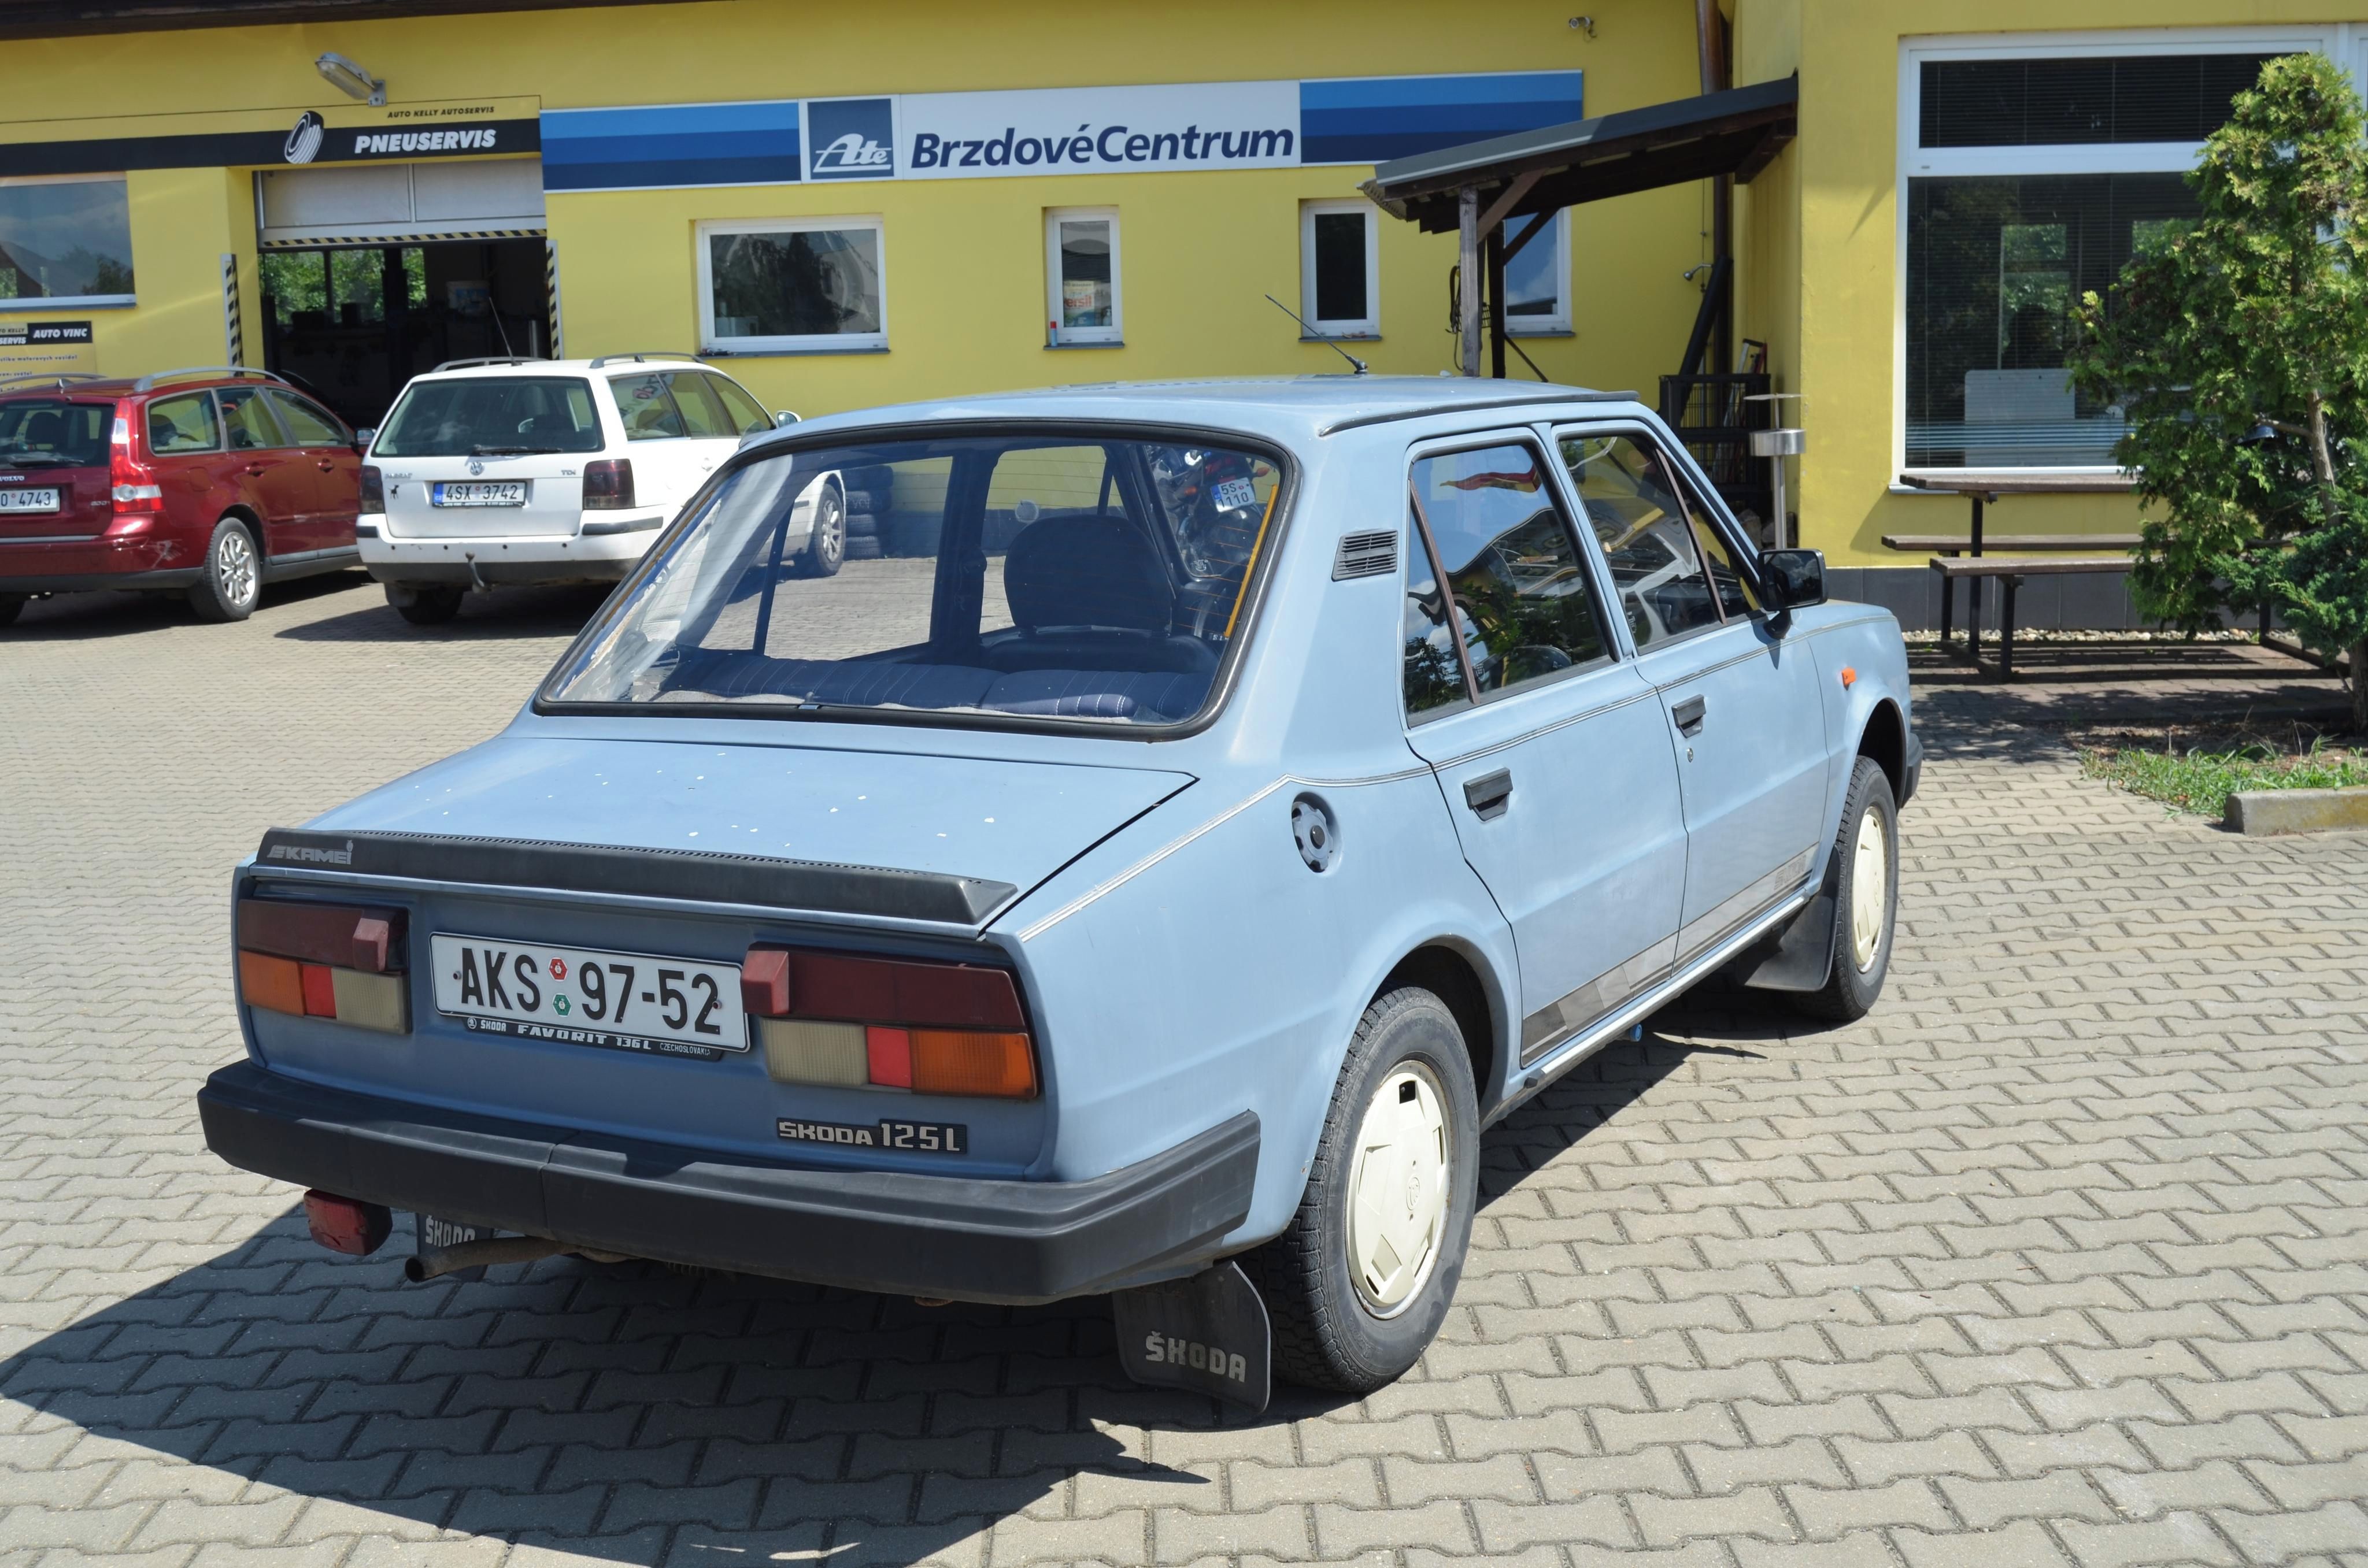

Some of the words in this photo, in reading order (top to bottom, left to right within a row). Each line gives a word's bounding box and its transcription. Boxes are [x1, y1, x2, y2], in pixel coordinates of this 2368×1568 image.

[387, 110, 411, 118] AUTO
[413, 109, 438, 117] KELLY
[354, 128, 497, 154] PNEUSERVIS
[33, 329, 61, 339] AUTO
[63, 328, 88, 338] VINC
[446, 485, 471, 501] 4SX
[483, 484, 518, 500] 3742
[1220, 483, 1237, 495] 5S
[18, 492, 51, 506] 4743
[1219, 492, 1249, 507] 1110
[461, 947, 541, 1012] AKS
[579, 961, 721, 1036] 97-52
[517, 1024, 607, 1044] FAVORIT
[1145, 1330, 1247, 1382] ŠKODA
